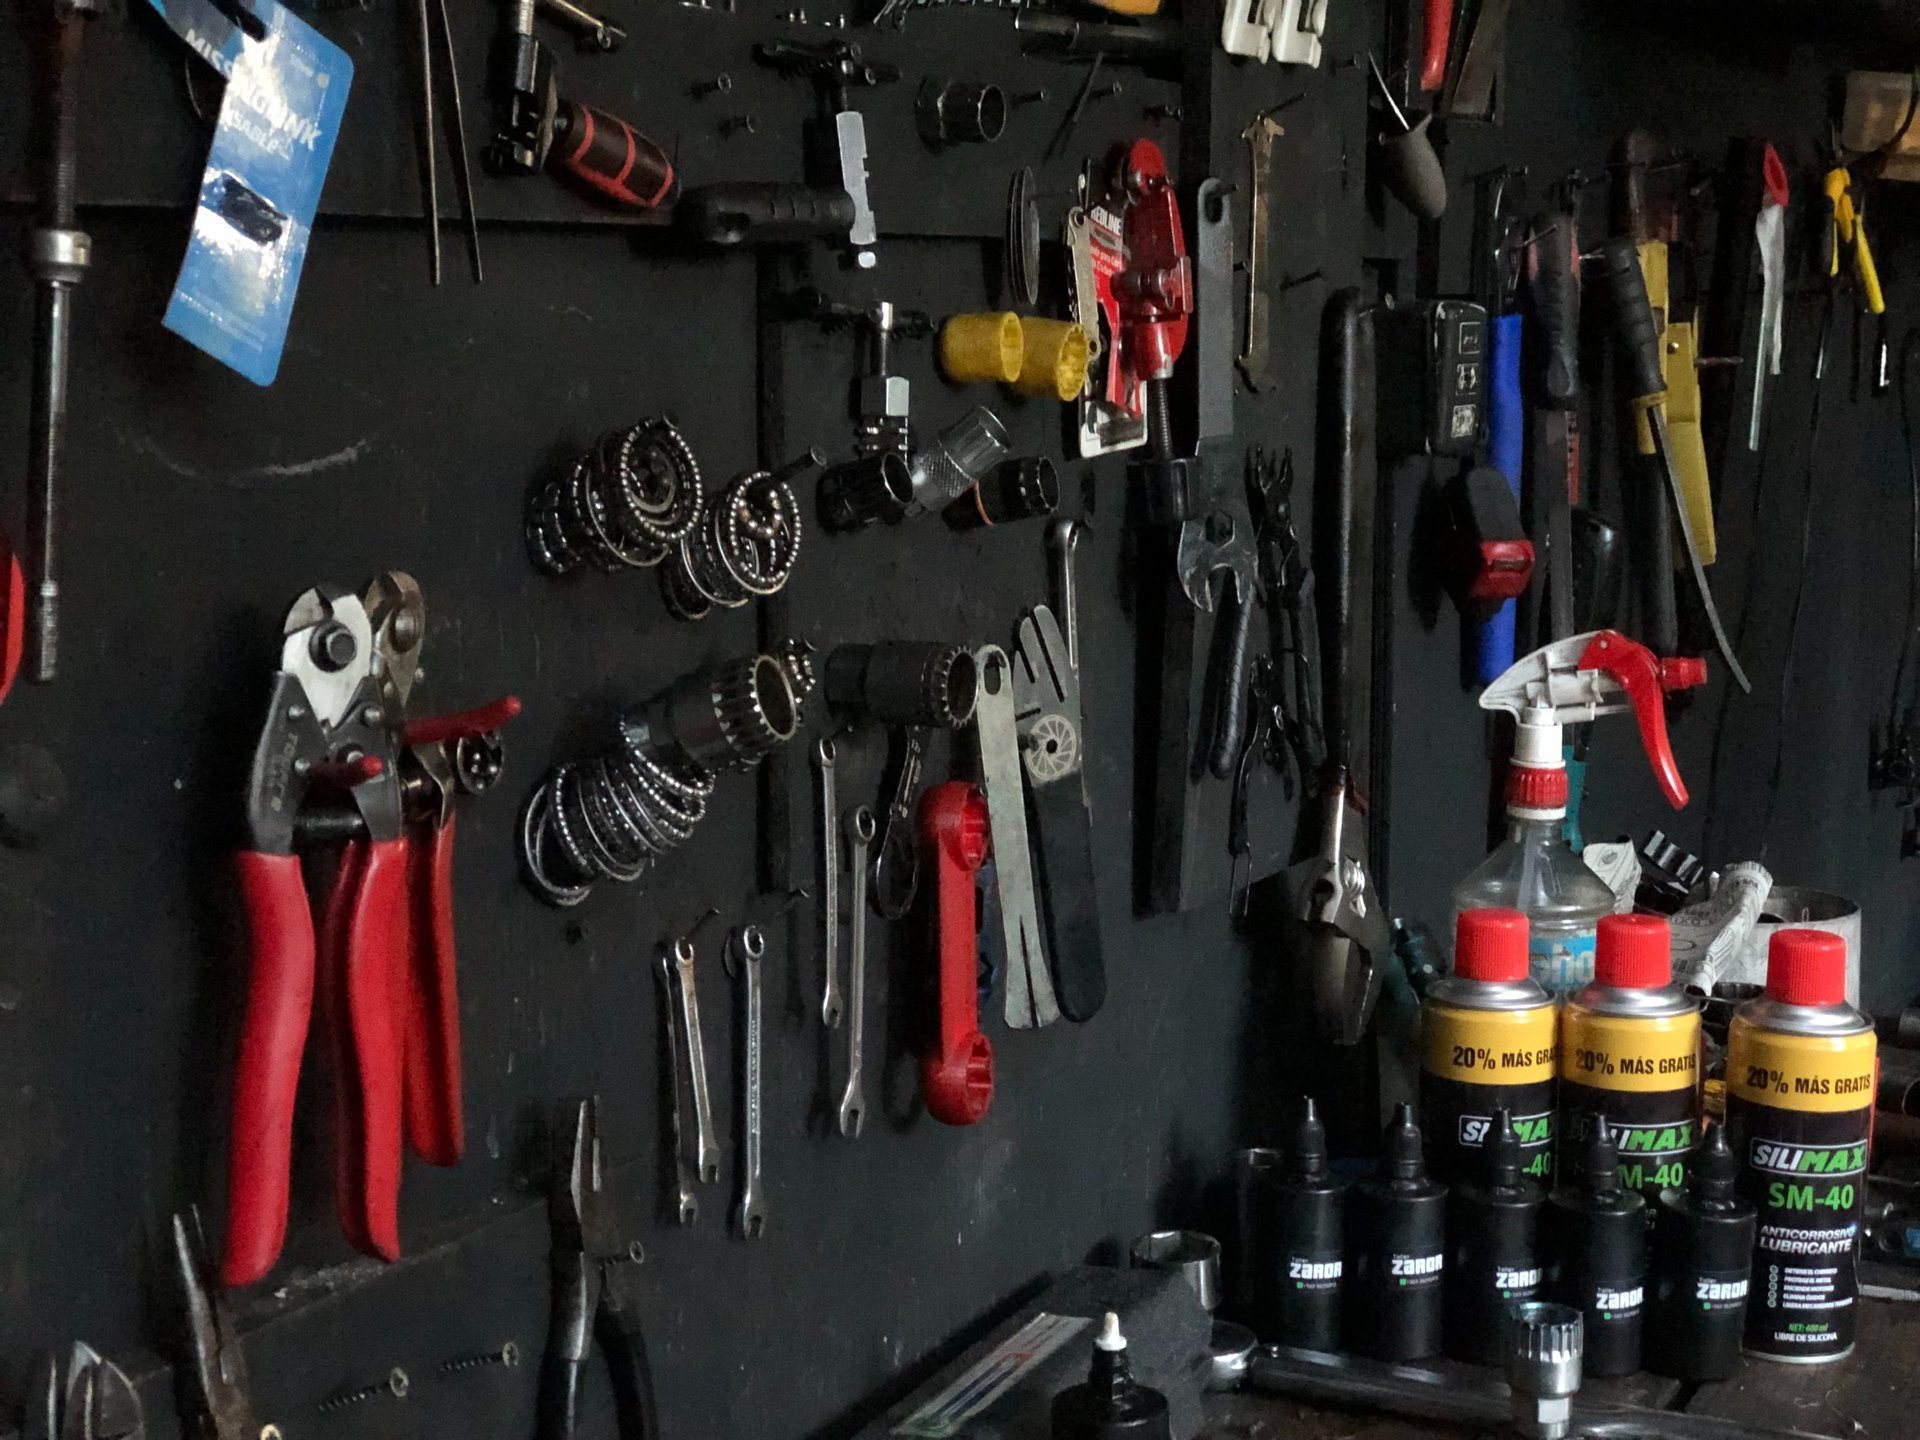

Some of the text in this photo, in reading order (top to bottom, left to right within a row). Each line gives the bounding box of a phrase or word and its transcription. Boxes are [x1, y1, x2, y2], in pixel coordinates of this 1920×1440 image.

[1453, 1045, 1556, 1070] 20% MÁS GRA
[1576, 1050, 1696, 1075] 20% MÁS GRATIS
[1747, 1065, 1871, 1094] 20% MÁS GRATIS
[1754, 1144, 1866, 1173] SILIMAX
[1619, 1162, 1684, 1190] M-40
[1769, 1182, 1854, 1212] SM-40
[1761, 1223, 1857, 1240] ANTICORROSIVO
[1760, 1236, 1852, 1254] LUBRICANTE
[1774, 1332, 1837, 1342] LIBRE DE SILICONA
